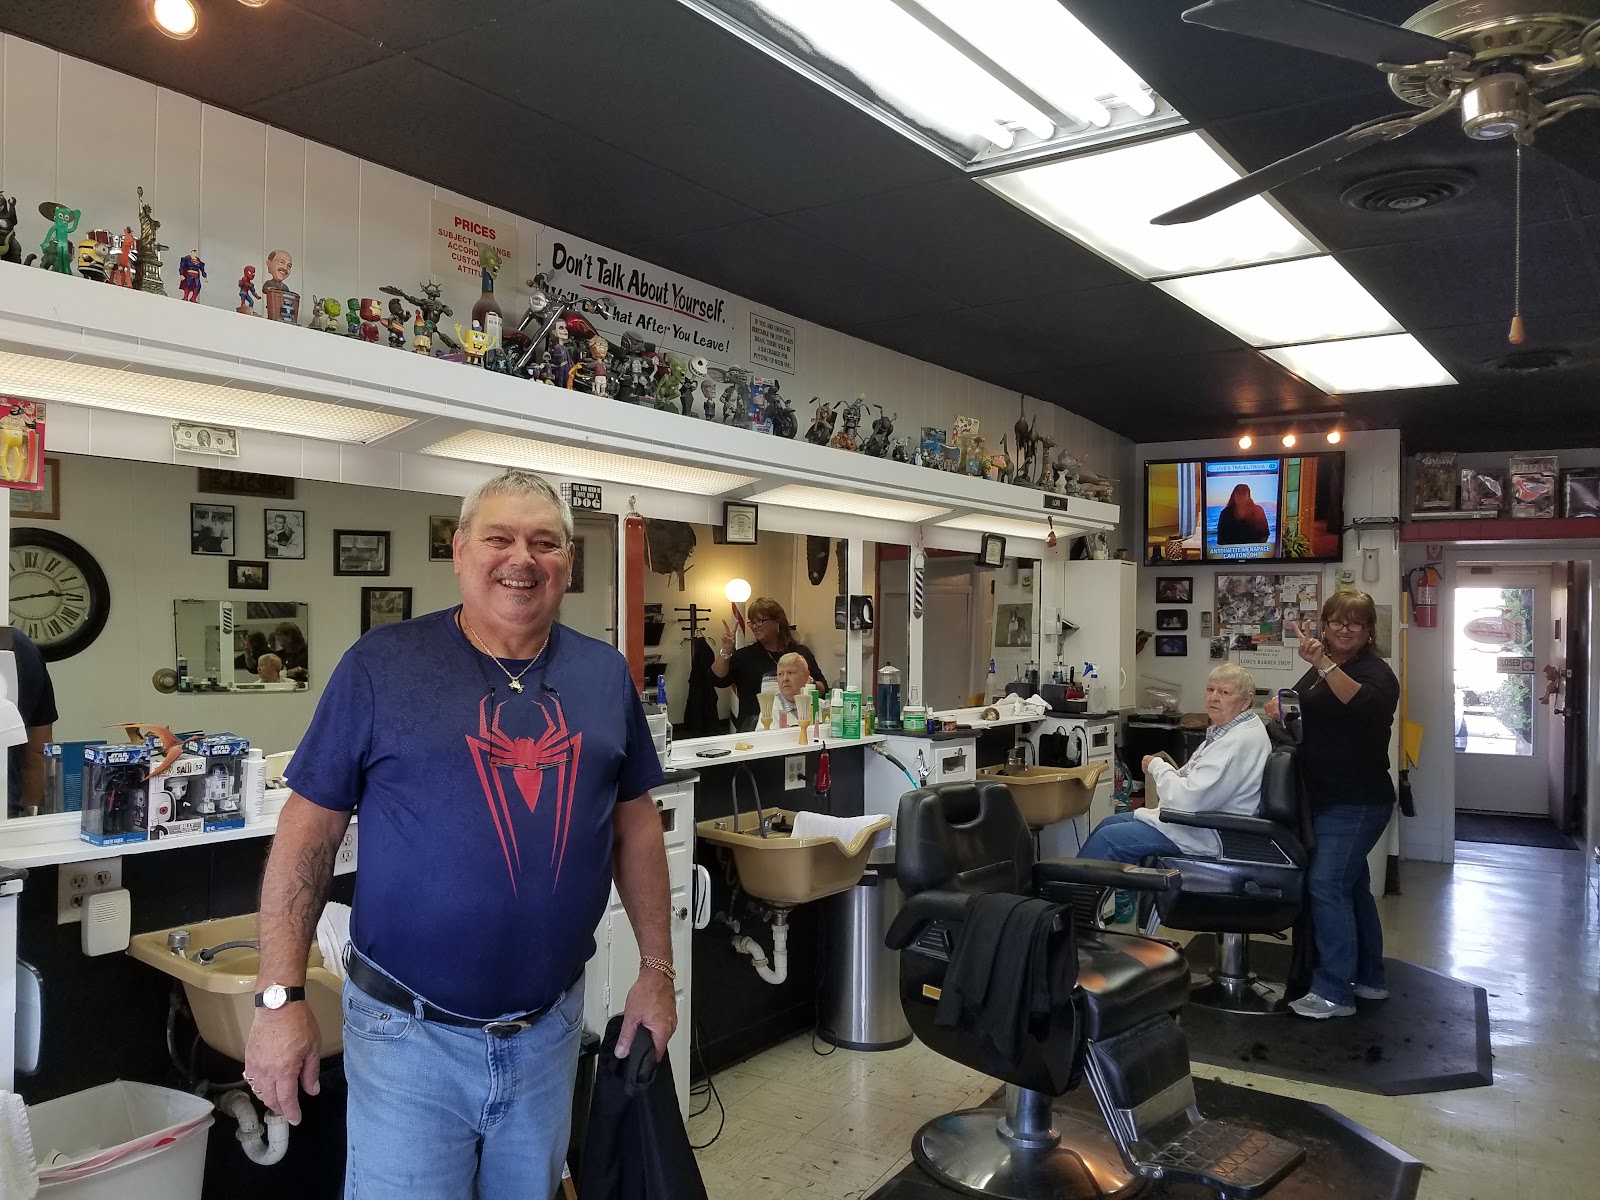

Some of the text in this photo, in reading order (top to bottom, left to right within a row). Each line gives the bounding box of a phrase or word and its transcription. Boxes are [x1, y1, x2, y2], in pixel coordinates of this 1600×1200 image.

[438, 228, 472, 245] SUBJECT
[454, 216, 496, 240] PRICES
[447, 241, 479, 257] ACCORD
[457, 264, 483, 278] ATTITU
[552, 242, 725, 324] Don't Talk About Yourself.
[635, 313, 671, 334] After
[673, 323, 691, 342] You
[693, 330, 730, 353] Leave!
[573, 497, 600, 508] DOG
